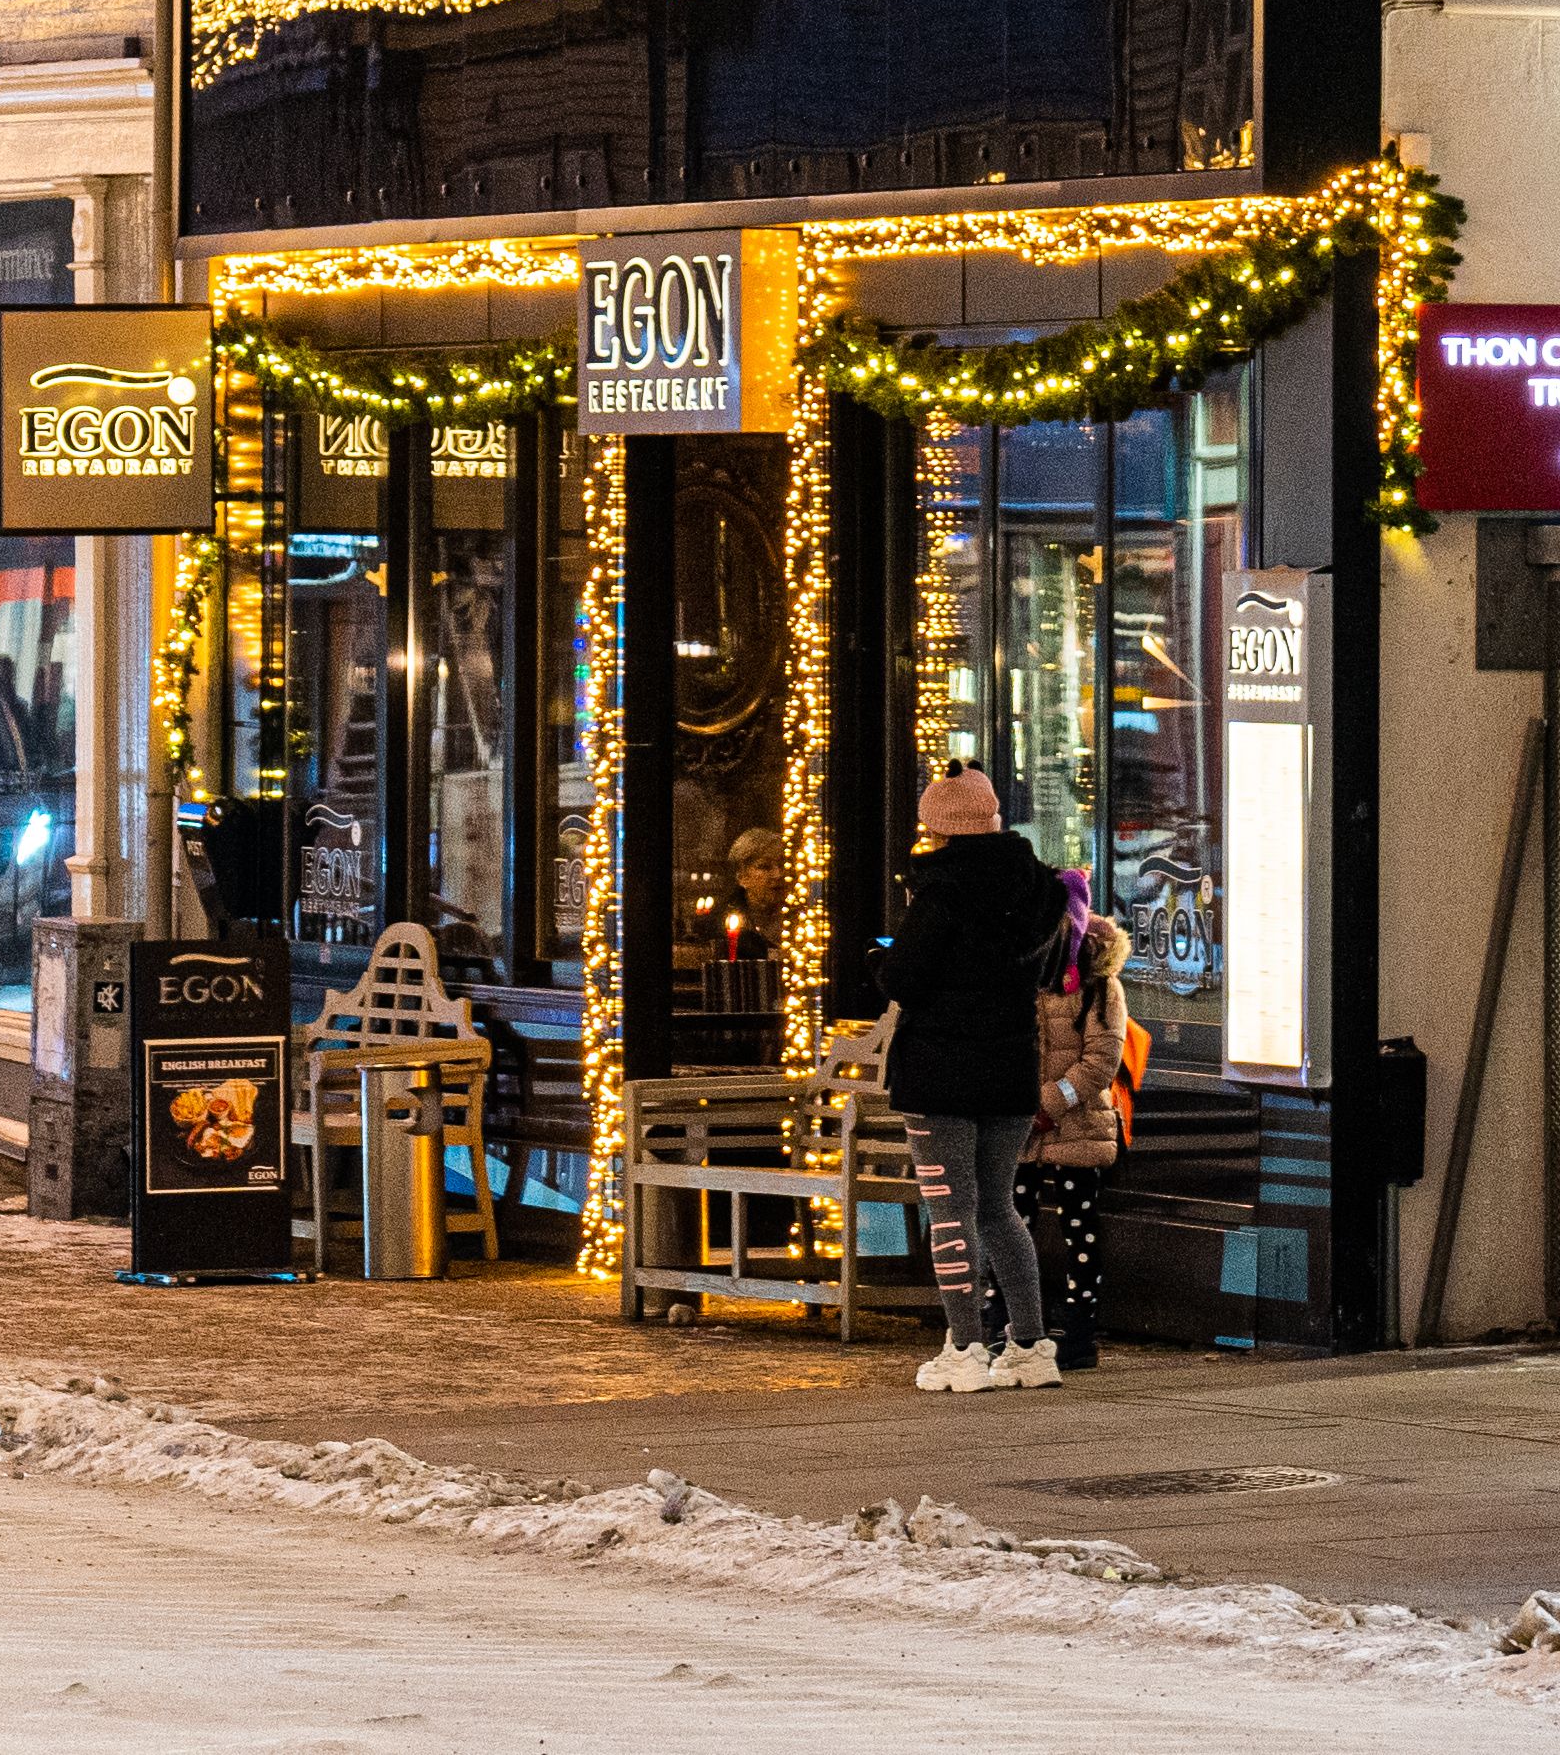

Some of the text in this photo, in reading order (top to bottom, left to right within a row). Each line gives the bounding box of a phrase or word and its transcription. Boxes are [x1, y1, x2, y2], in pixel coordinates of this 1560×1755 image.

[585, 254, 732, 371] EGON
[1441, 337, 1537, 367] THON
[588, 376, 729, 413] RESTAURANT
[19, 405, 198, 458] EGON
[22, 458, 193, 477] RESTAURANT
[1227, 626, 1303, 675] EGON
[301, 846, 361, 898] EGON
[1131, 904, 1214, 966] EGON
[158, 975, 264, 1004] EGON
[160, 1058, 267, 1071] ENGLISH BREAKFAST
[248, 1171, 278, 1181] EGON
